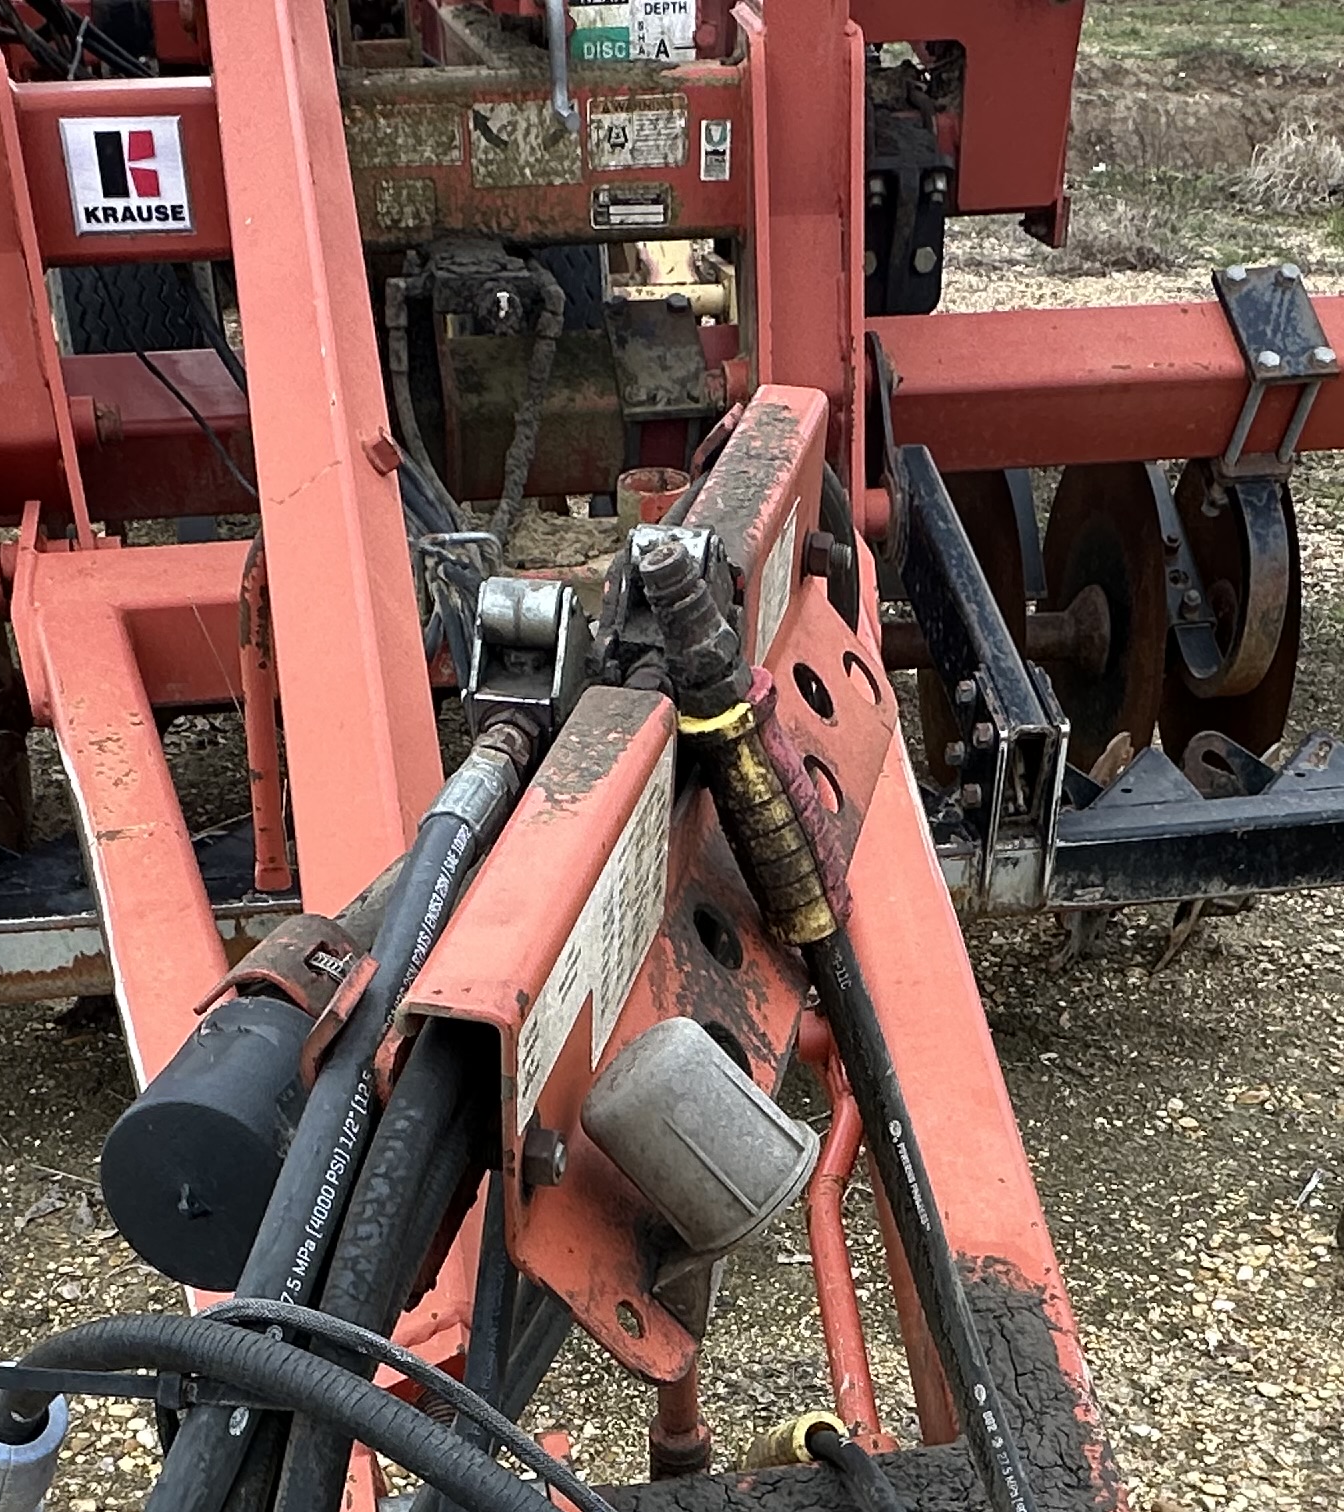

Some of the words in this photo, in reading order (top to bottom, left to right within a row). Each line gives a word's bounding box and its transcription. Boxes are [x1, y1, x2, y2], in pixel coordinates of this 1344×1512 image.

[644, 1, 687, 16] DEPTH
[583, 41, 626, 60] DISC
[655, 38, 669, 58] A
[84, 205, 186, 223] KRAUSE
[280, 1276, 302, 1305] 7.5
[292, 1238, 316, 1277] MPa
